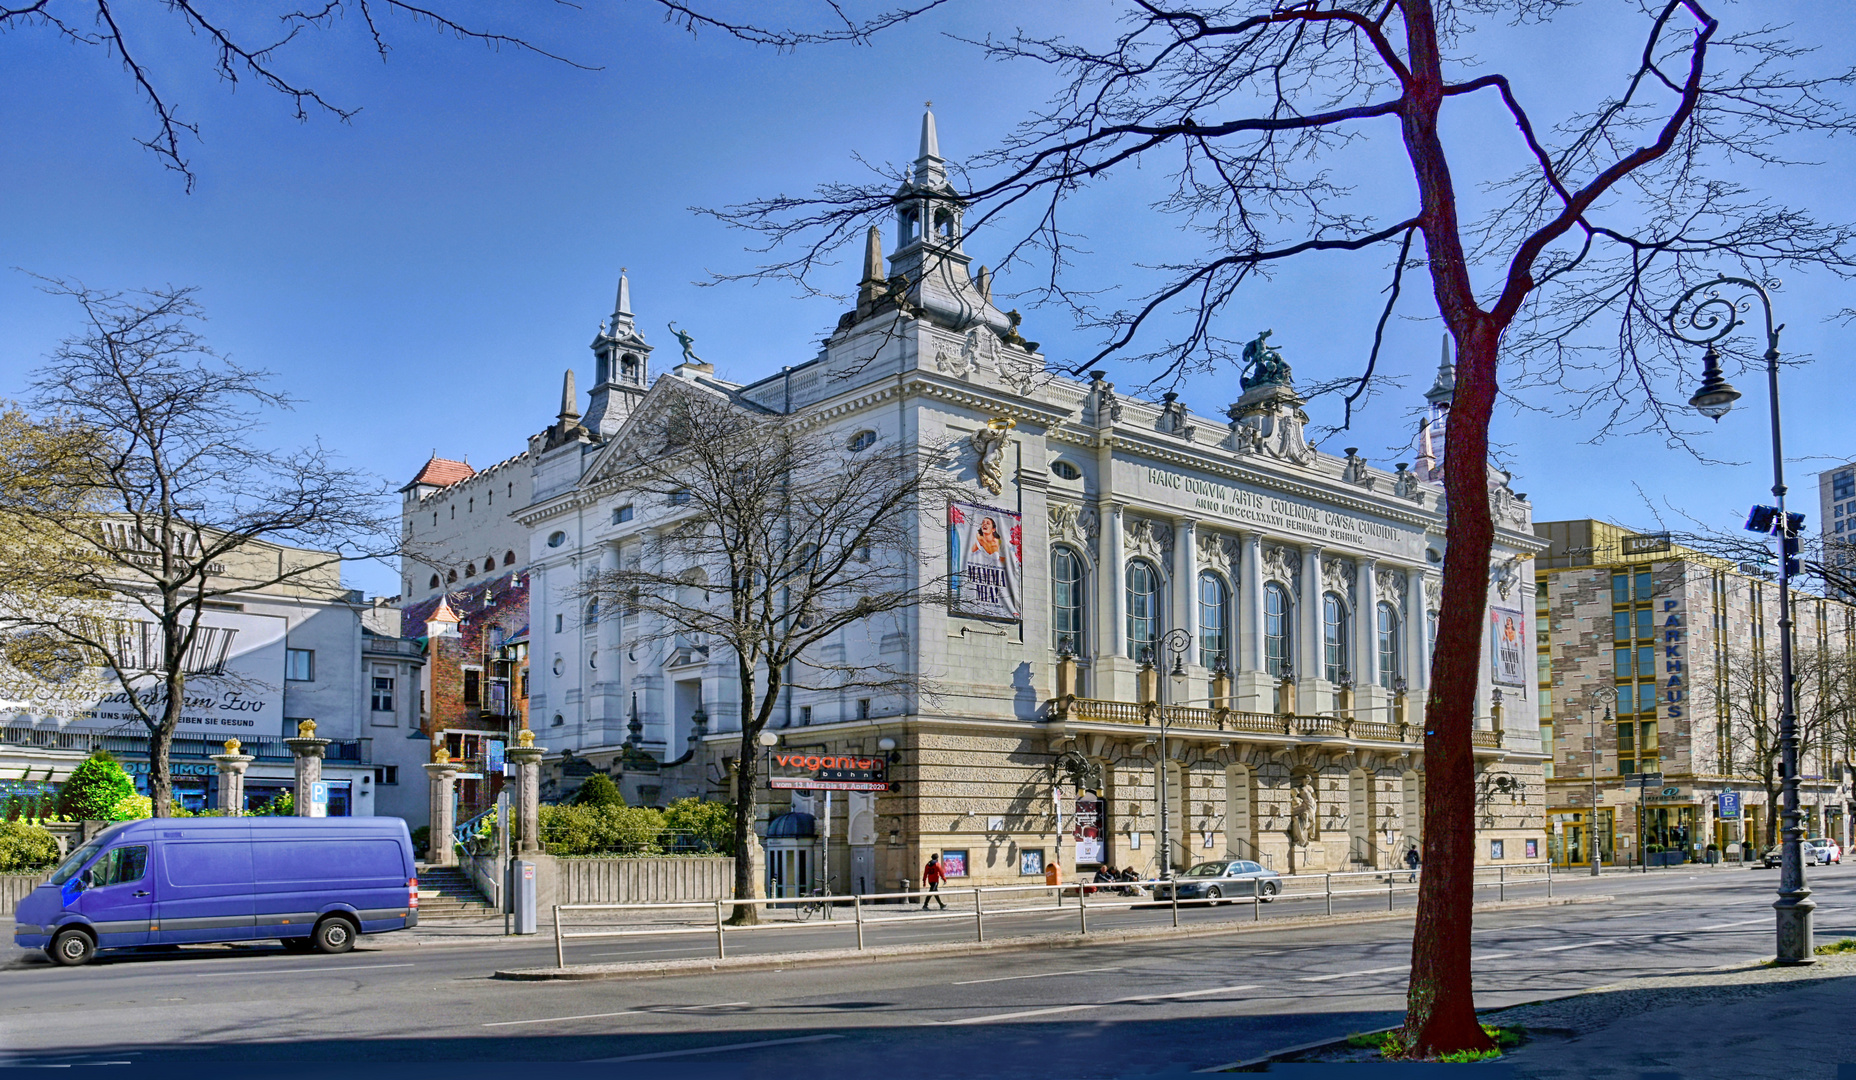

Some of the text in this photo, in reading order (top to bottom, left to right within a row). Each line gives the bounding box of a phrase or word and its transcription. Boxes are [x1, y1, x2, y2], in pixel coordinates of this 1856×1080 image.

[1148, 468, 1401, 541] HANC DOMVM ARTIS COLENDAE CAVSA CONDIDIT.
[1195, 498, 1219, 512] ANNO
[1286, 518, 1327, 537] BERNHARD
[1330, 529, 1365, 545] SEHRING.
[1632, 537, 1660, 549] LUX
[967, 565, 1006, 587] MAMMA
[976, 584, 999, 604] MIA!
[1663, 600, 1682, 718] PARKHAUS
[219, 691, 265, 712] Zoo
[101, 711, 119, 720] UNS
[221, 719, 254, 727] GESUND
[776, 755, 884, 771] vaganten
[314, 785, 324, 800] P
[1725, 796, 1734, 806] P
